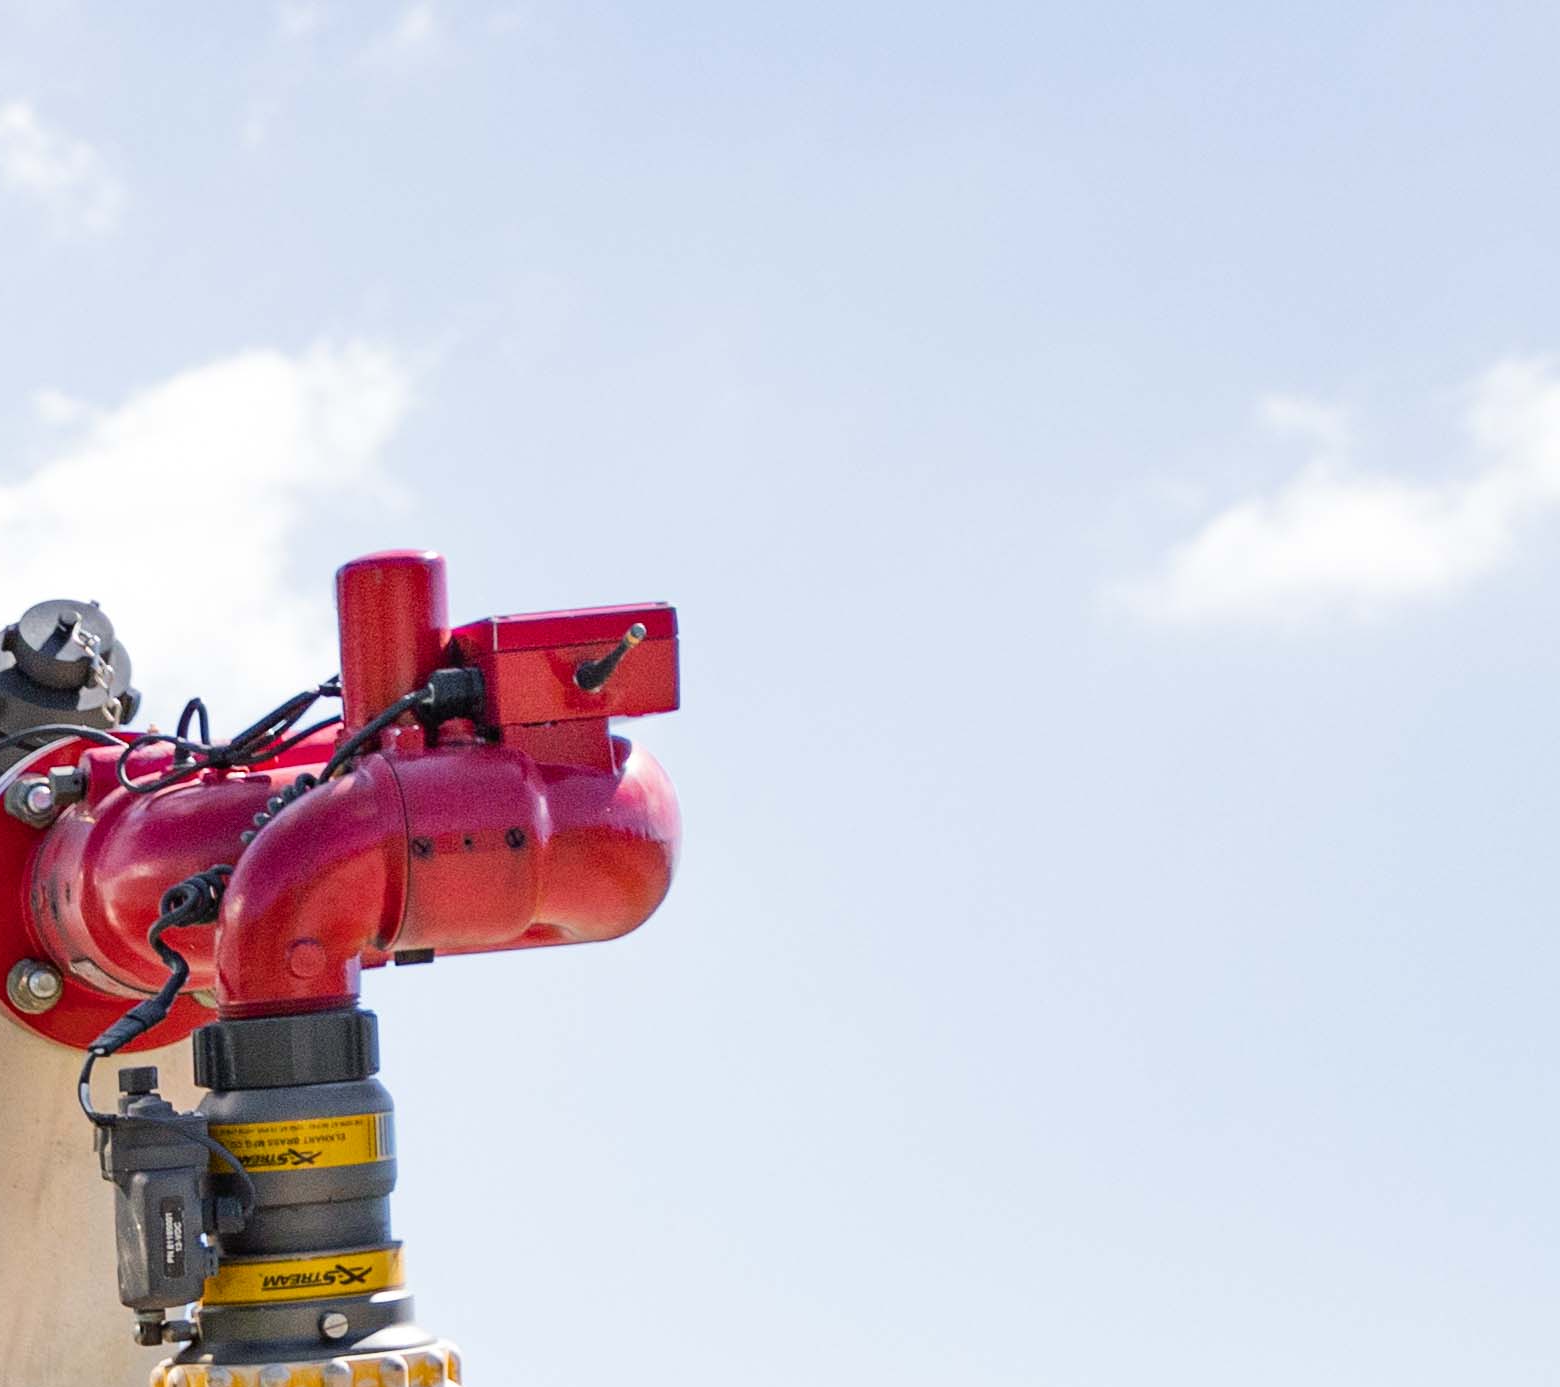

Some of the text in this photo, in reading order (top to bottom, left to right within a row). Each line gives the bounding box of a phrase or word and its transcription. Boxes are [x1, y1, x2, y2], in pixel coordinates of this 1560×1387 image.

[267, 1137, 300, 1147] BRASS
[237, 1148, 323, 1167] X-STREA
[261, 1264, 373, 1291] X-STREAM
